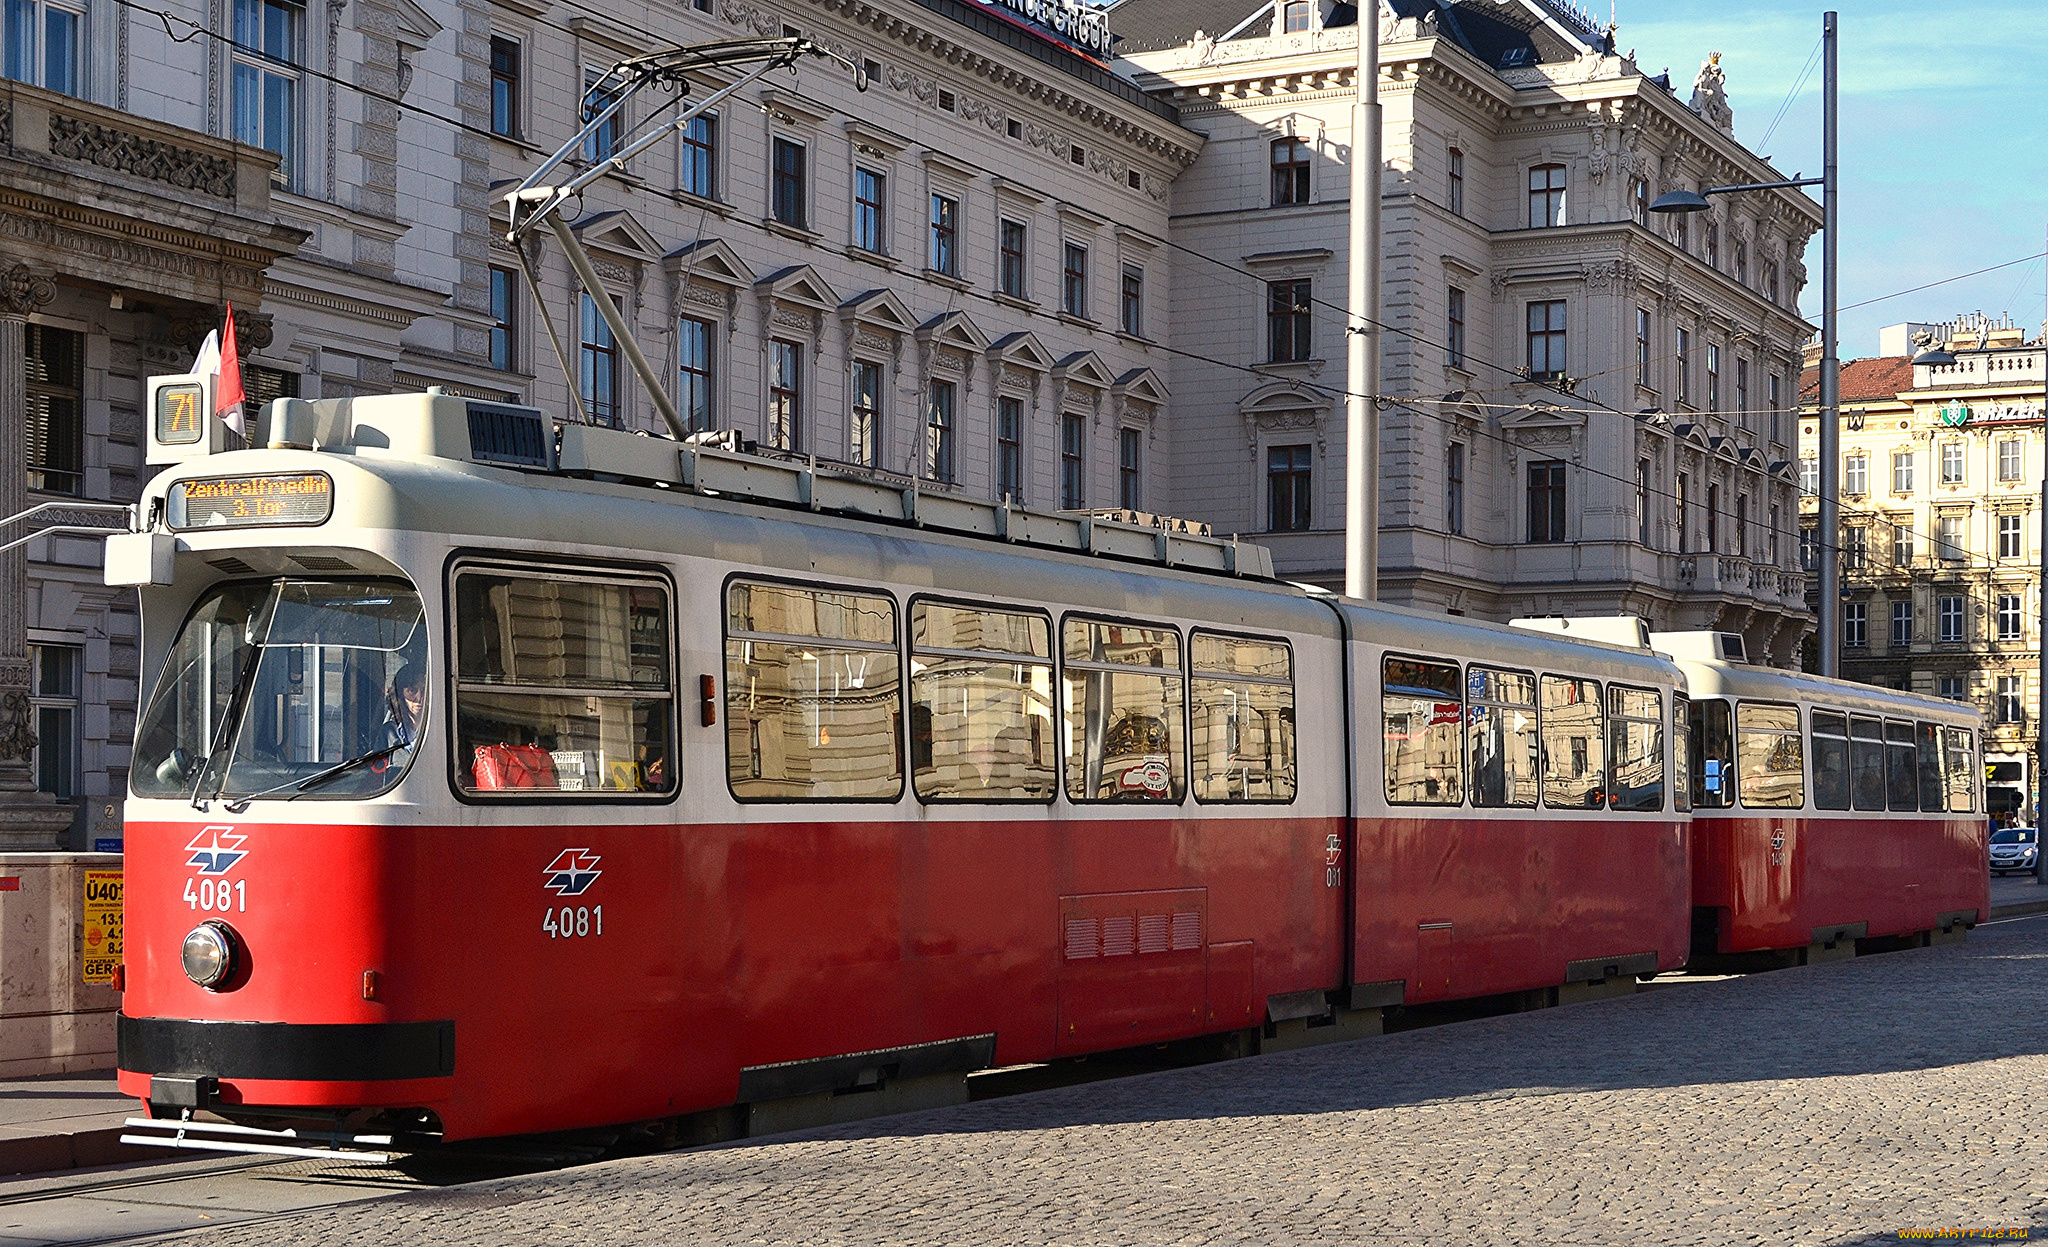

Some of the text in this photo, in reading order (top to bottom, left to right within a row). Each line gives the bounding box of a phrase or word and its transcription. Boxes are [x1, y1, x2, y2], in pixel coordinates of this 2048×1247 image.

[168, 392, 195, 431] 71
[254, 498, 287, 516] Tor
[183, 877, 246, 912] 4081
[542, 904, 602, 939] 4081
